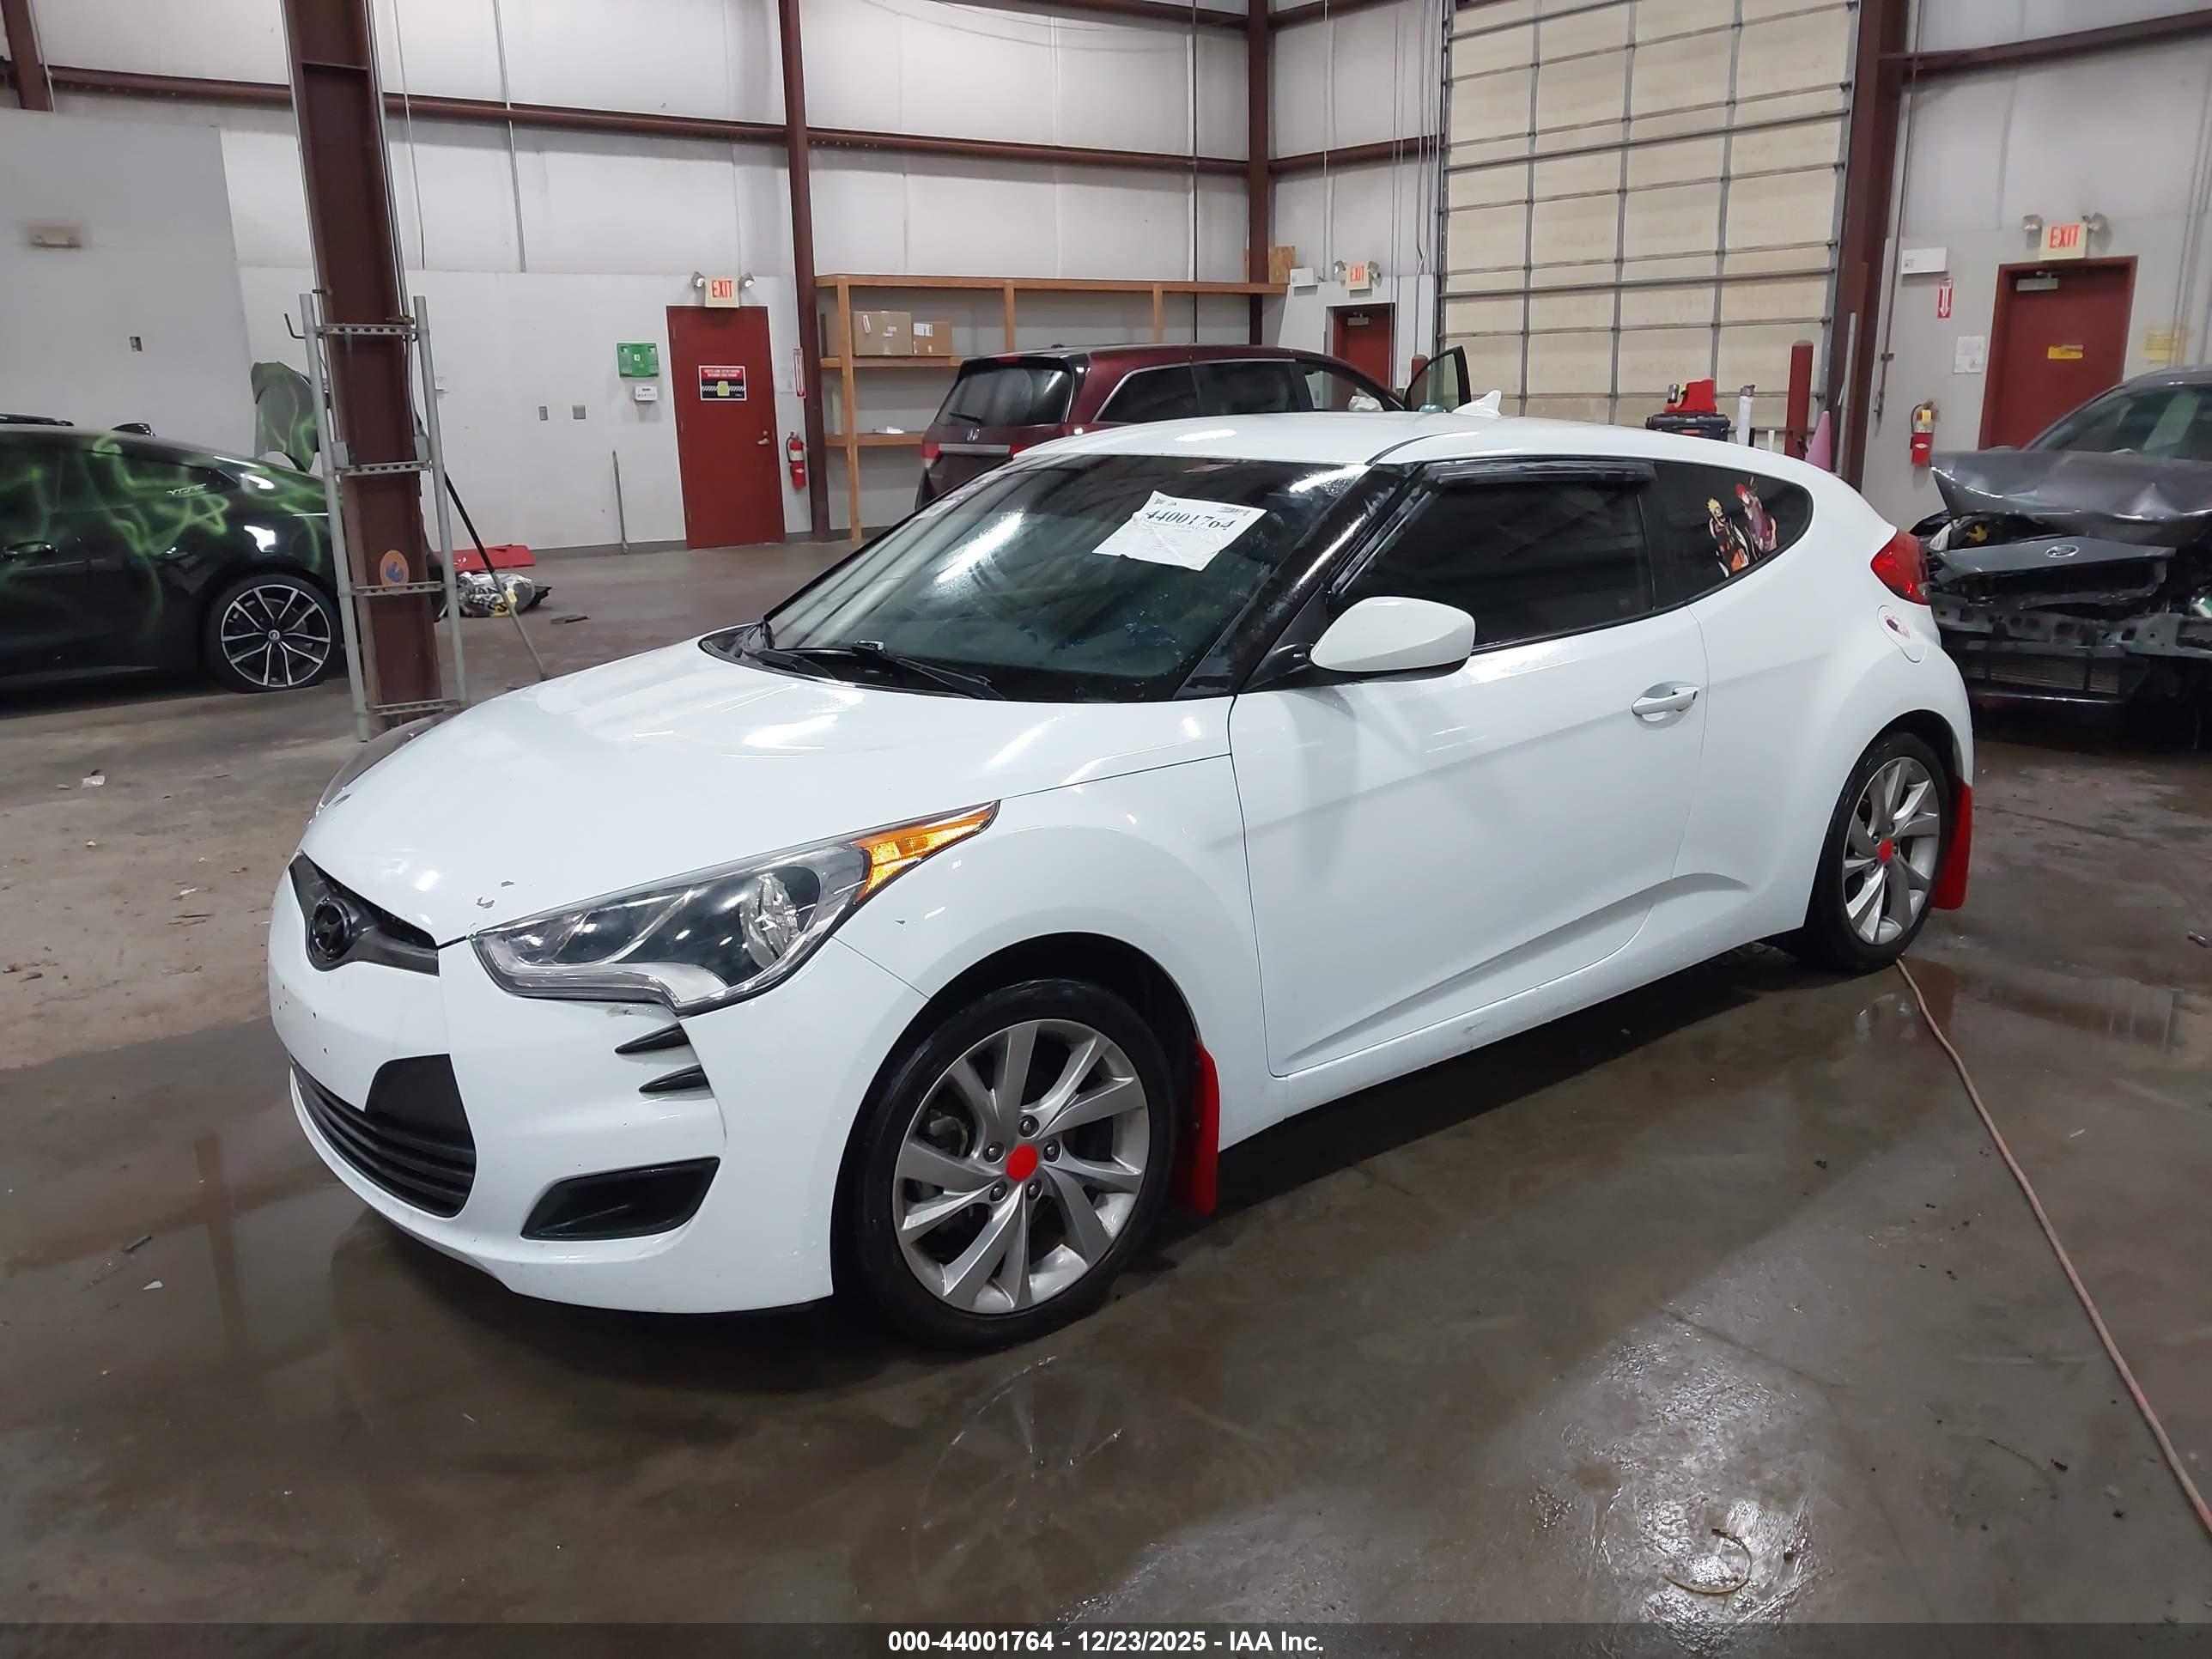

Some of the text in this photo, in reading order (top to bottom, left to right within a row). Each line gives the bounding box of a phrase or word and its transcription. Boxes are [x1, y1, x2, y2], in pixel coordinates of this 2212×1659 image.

[2049, 224, 2080, 249] EXIT
[711, 279, 733, 298] EXIT
[1145, 508, 1237, 531] 44001764
